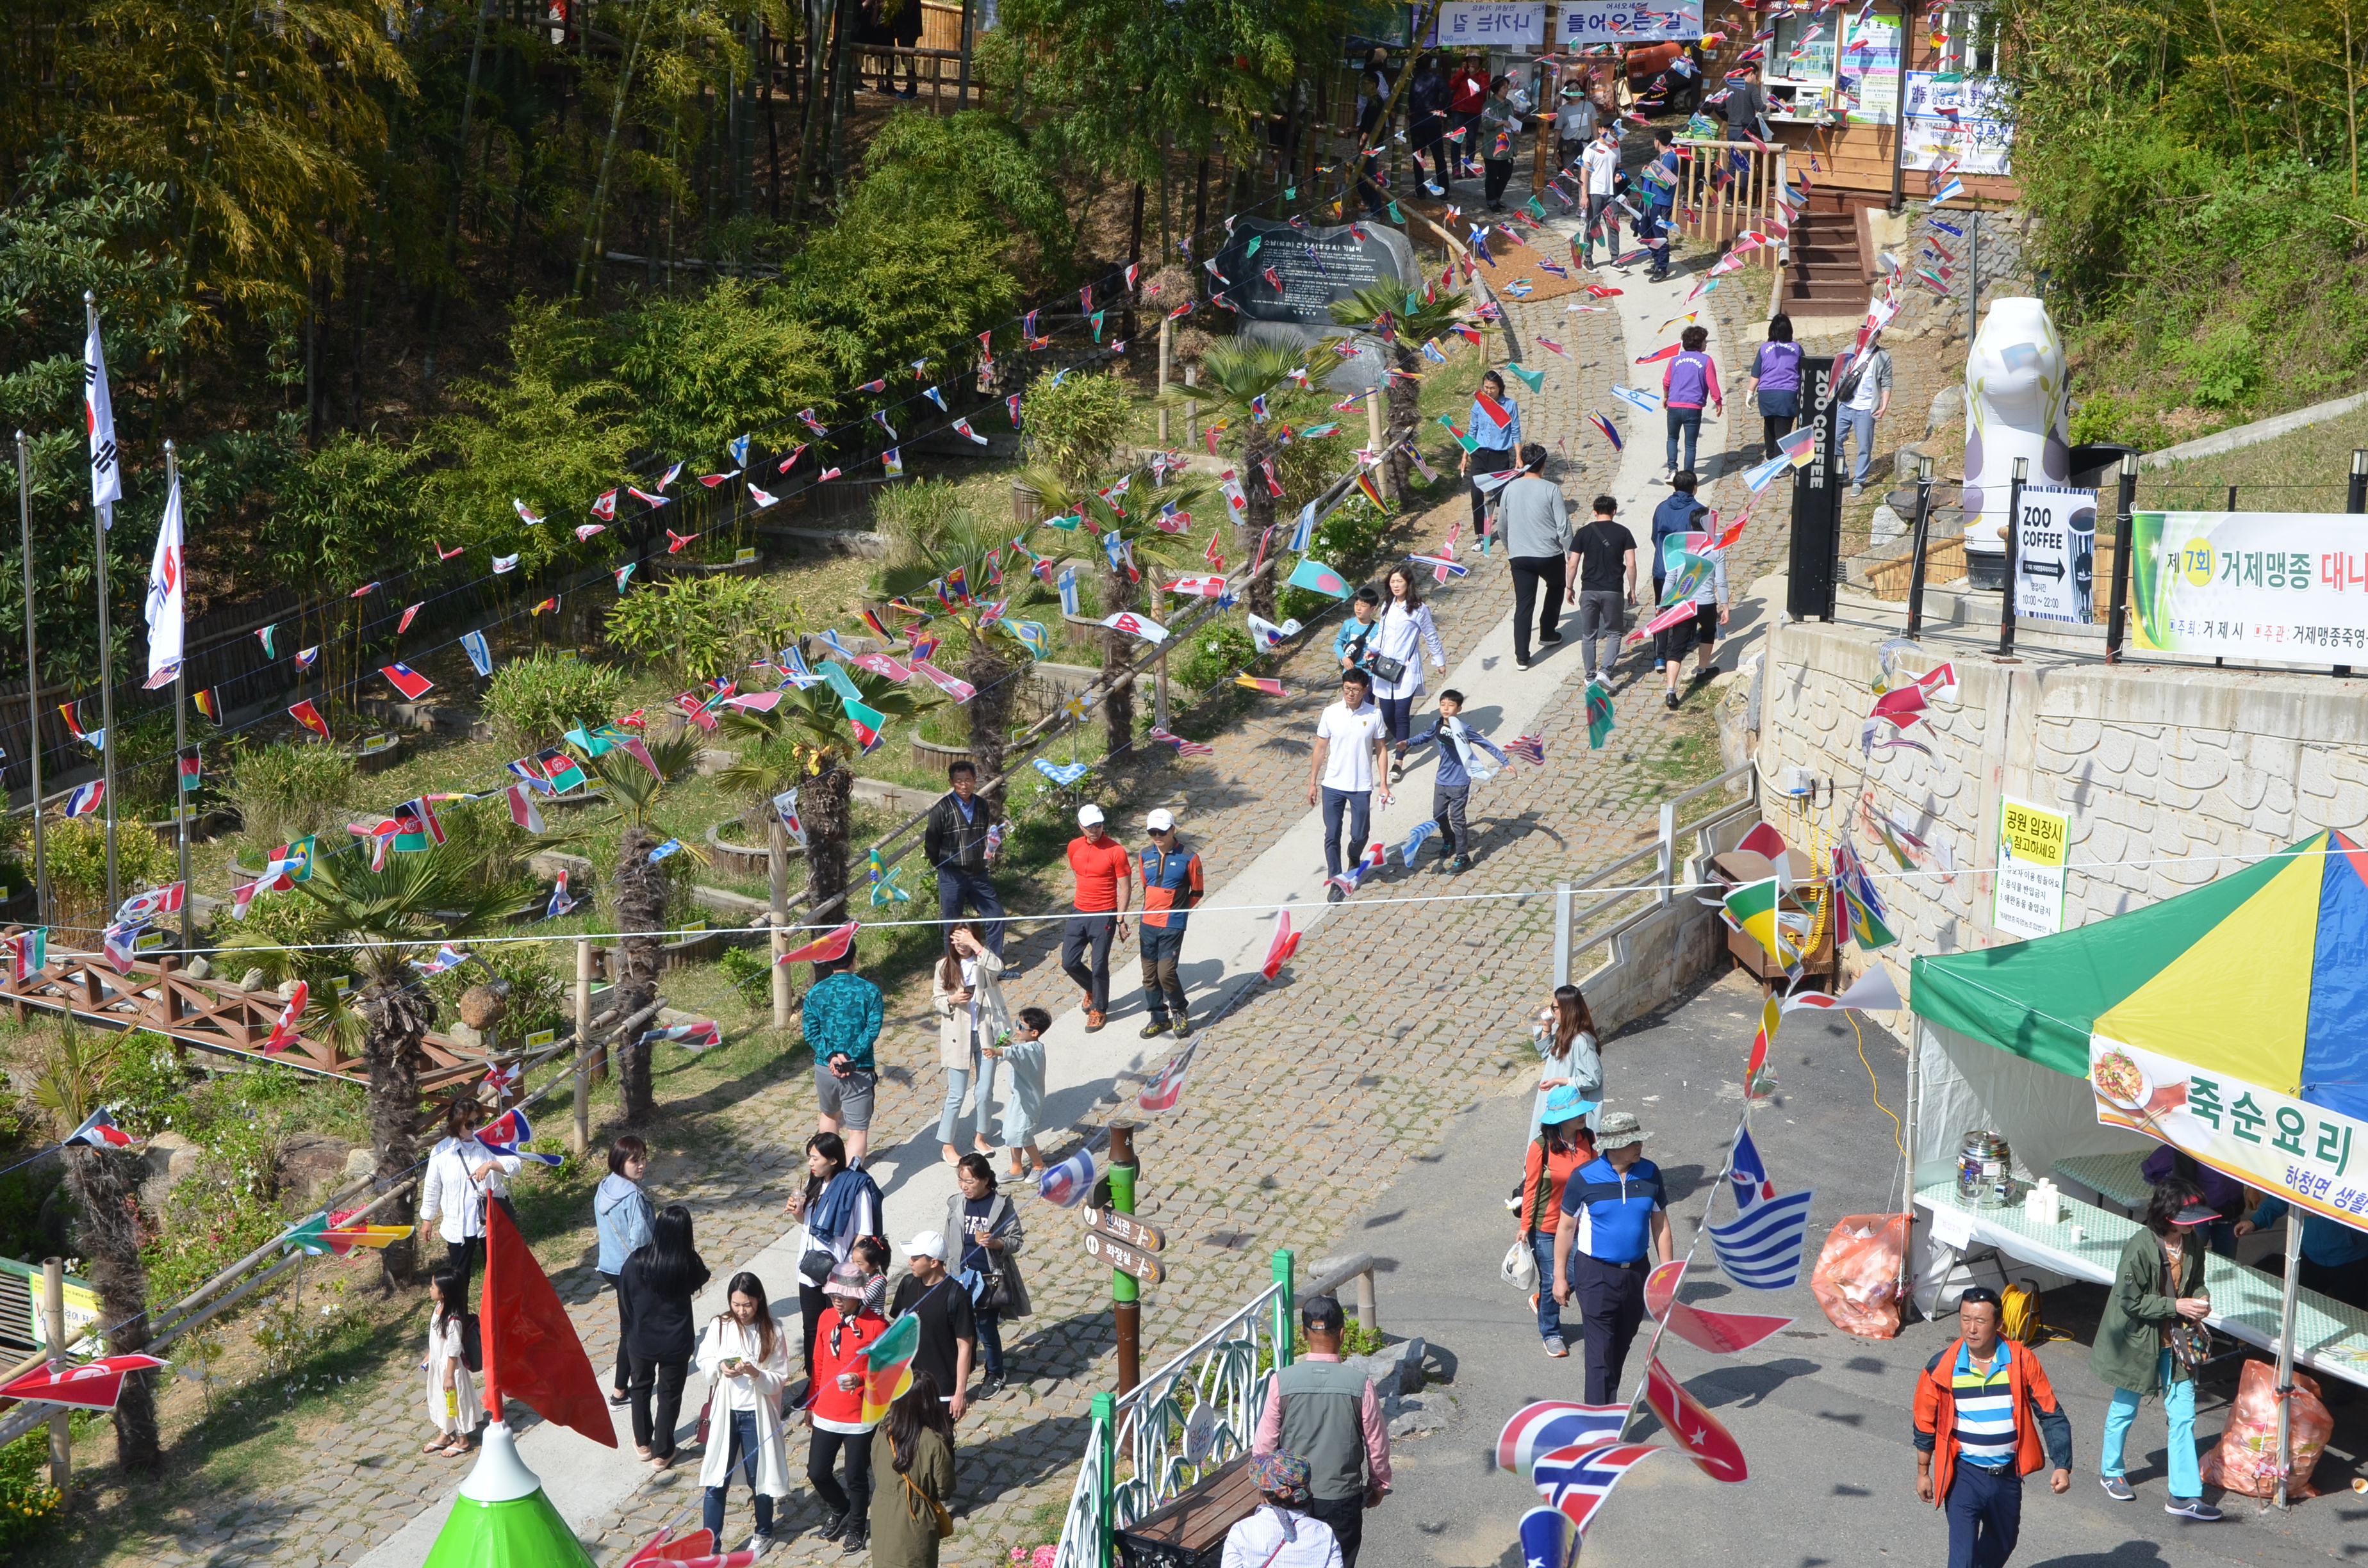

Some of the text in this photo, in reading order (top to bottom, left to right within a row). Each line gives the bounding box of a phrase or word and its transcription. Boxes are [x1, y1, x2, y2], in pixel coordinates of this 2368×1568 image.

[1567, 13, 1651, 33] 들어오는
[1911, 85, 1927, 104] 합동
[1343, 245, 1362, 253] 기념비
[1809, 370, 1830, 489] ZOO COFFEE
[2023, 506, 2051, 528] ZOO
[2023, 530, 2062, 550] COFFEE
[2167, 552, 2180, 573] 제
[2185, 549, 2210, 576] 7회
[2221, 550, 2312, 589] 거제맹종
[2031, 582, 2047, 593] 영업시간
[2022, 594, 2037, 607] 10:00
[2044, 596, 2059, 609] 22:00
[2203, 620, 2244, 641] 거제시
[2292, 626, 2368, 649] 거제맹종죽영
[2007, 810, 2063, 843] 공원 입장시
[2014, 835, 2056, 860] 참고하세요
[2024, 870, 2035, 883] 이용
[2037, 874, 2060, 888] 힘들어요
[2023, 885, 2046, 901] 반입금지
[2028, 902, 2051, 917] 출입금지
[2187, 1074, 2353, 1179] 죽순요리
[2285, 1165, 2368, 1215] 하청면 생활
[1105, 1213, 1131, 1235] 전시관
[1106, 1243, 1131, 1266] 화장실
